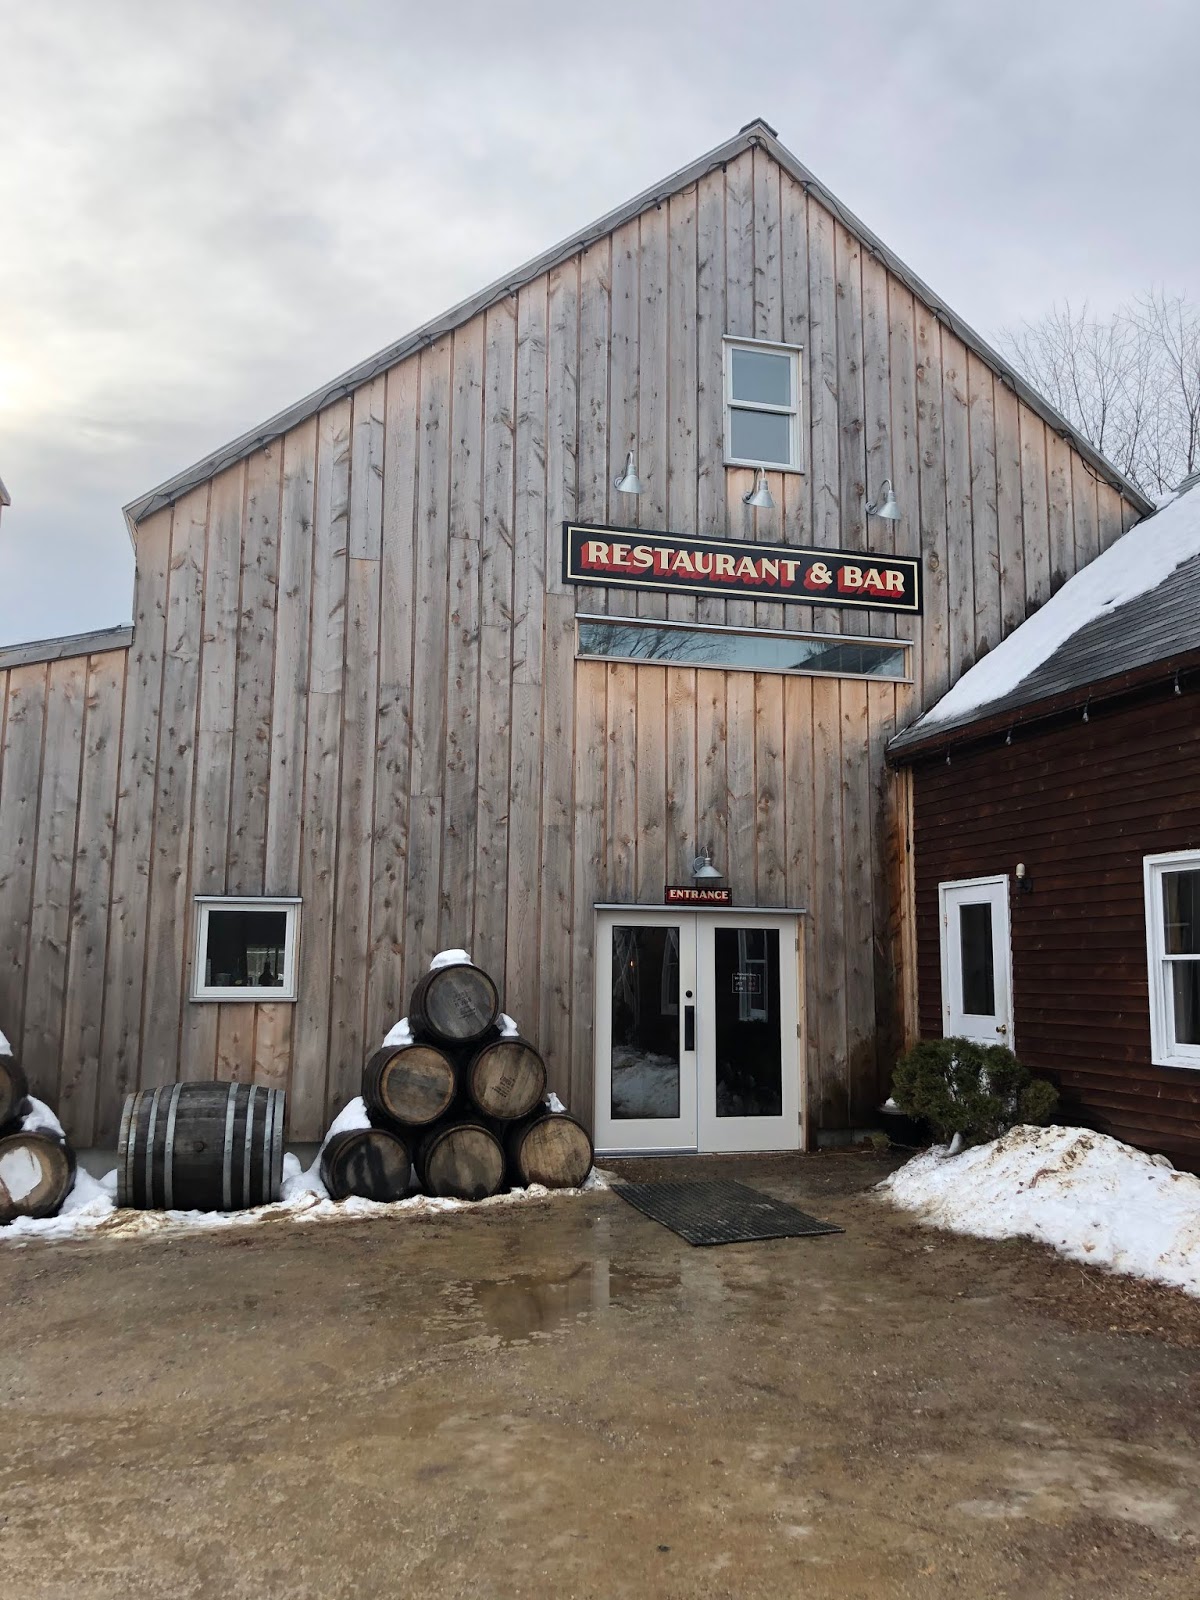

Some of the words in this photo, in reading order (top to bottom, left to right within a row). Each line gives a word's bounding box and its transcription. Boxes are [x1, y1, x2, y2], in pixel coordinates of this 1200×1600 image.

[583, 541, 801, 585] RESTAURANT
[805, 562, 833, 588] &
[839, 565, 905, 595] BAR
[669, 889, 729, 900] ENTRANCE
